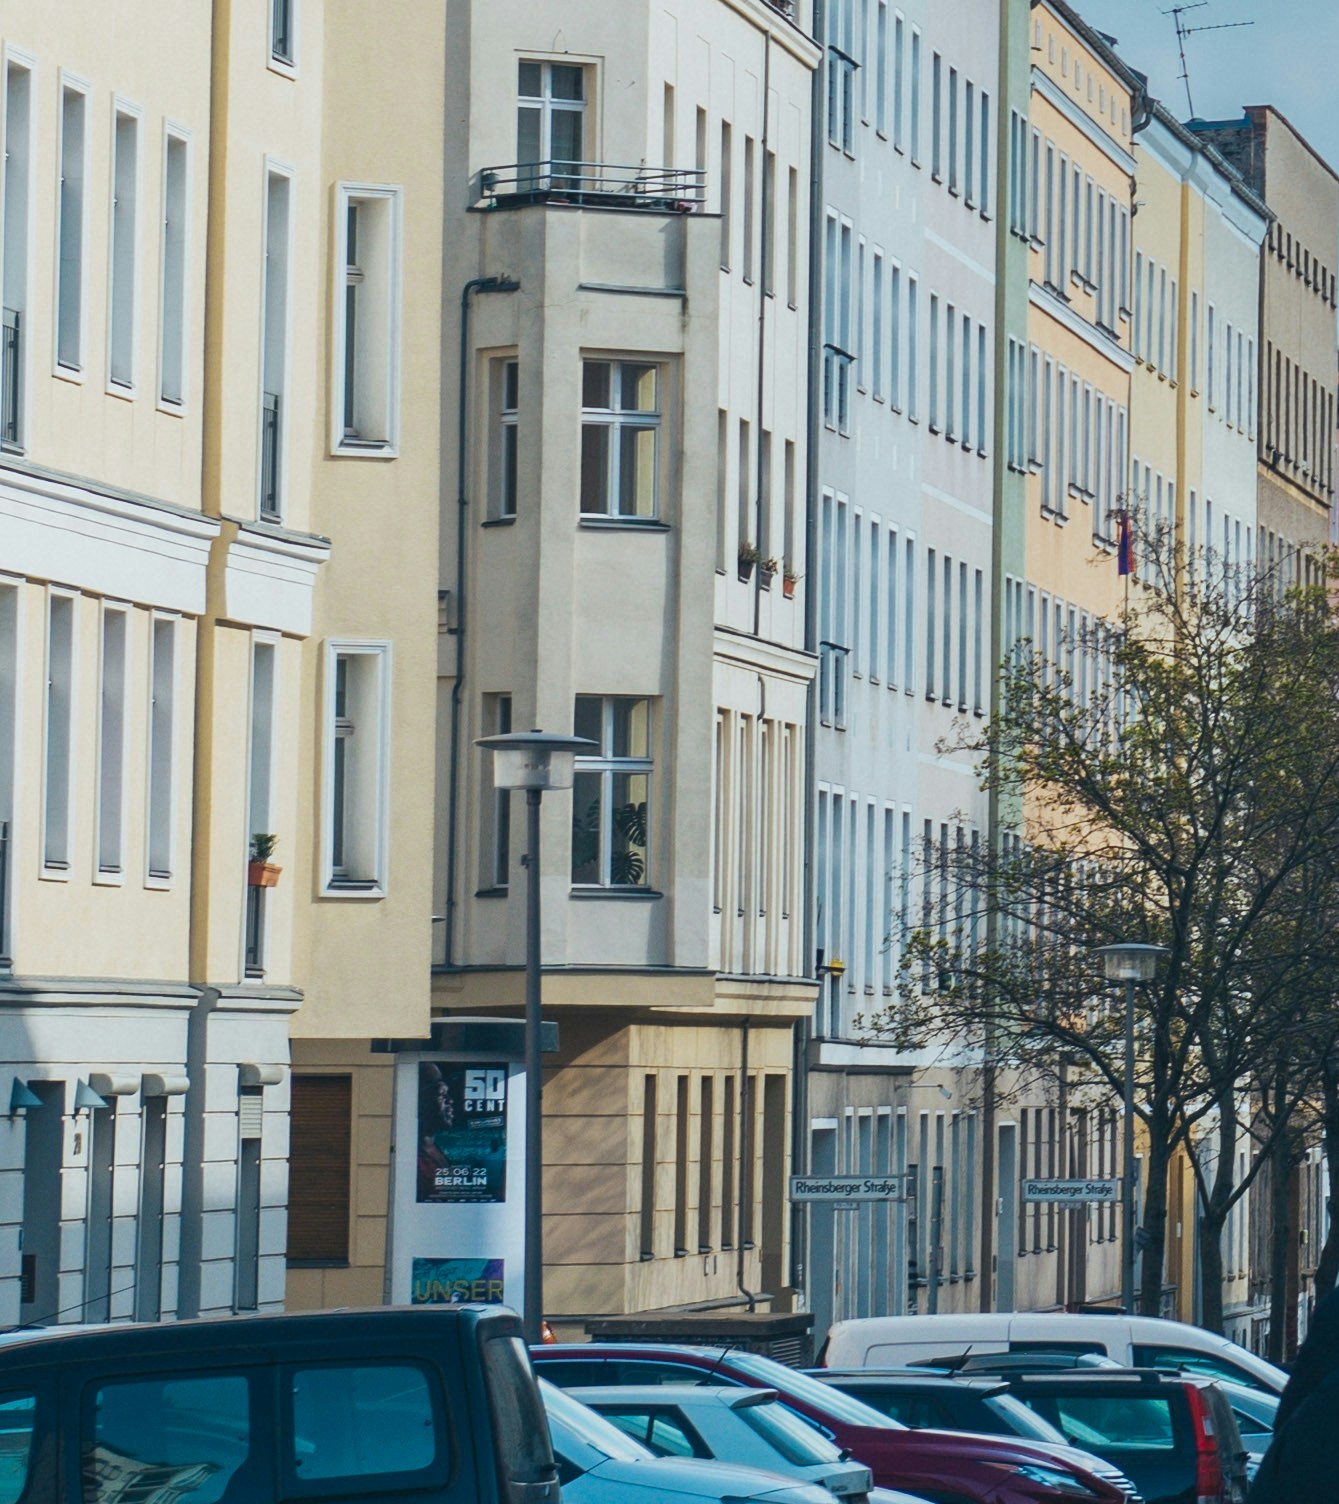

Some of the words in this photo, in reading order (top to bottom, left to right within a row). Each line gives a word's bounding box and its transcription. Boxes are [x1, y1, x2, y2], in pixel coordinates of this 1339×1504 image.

[465, 1070, 505, 1099] 50
[465, 1100, 505, 1111] CENT
[435, 1168, 449, 1176] 25
[452, 1168, 470, 1176] 06
[473, 1168, 487, 1176] 22
[434, 1177, 487, 1186] BERLIN
[796, 1181, 861, 1196] Rheinsberger
[864, 1180, 896, 1195] Straße
[1028, 1184, 1083, 1197] Rheinsberger
[1085, 1183, 1113, 1196] Straße
[415, 1280, 504, 1301] UNSER
